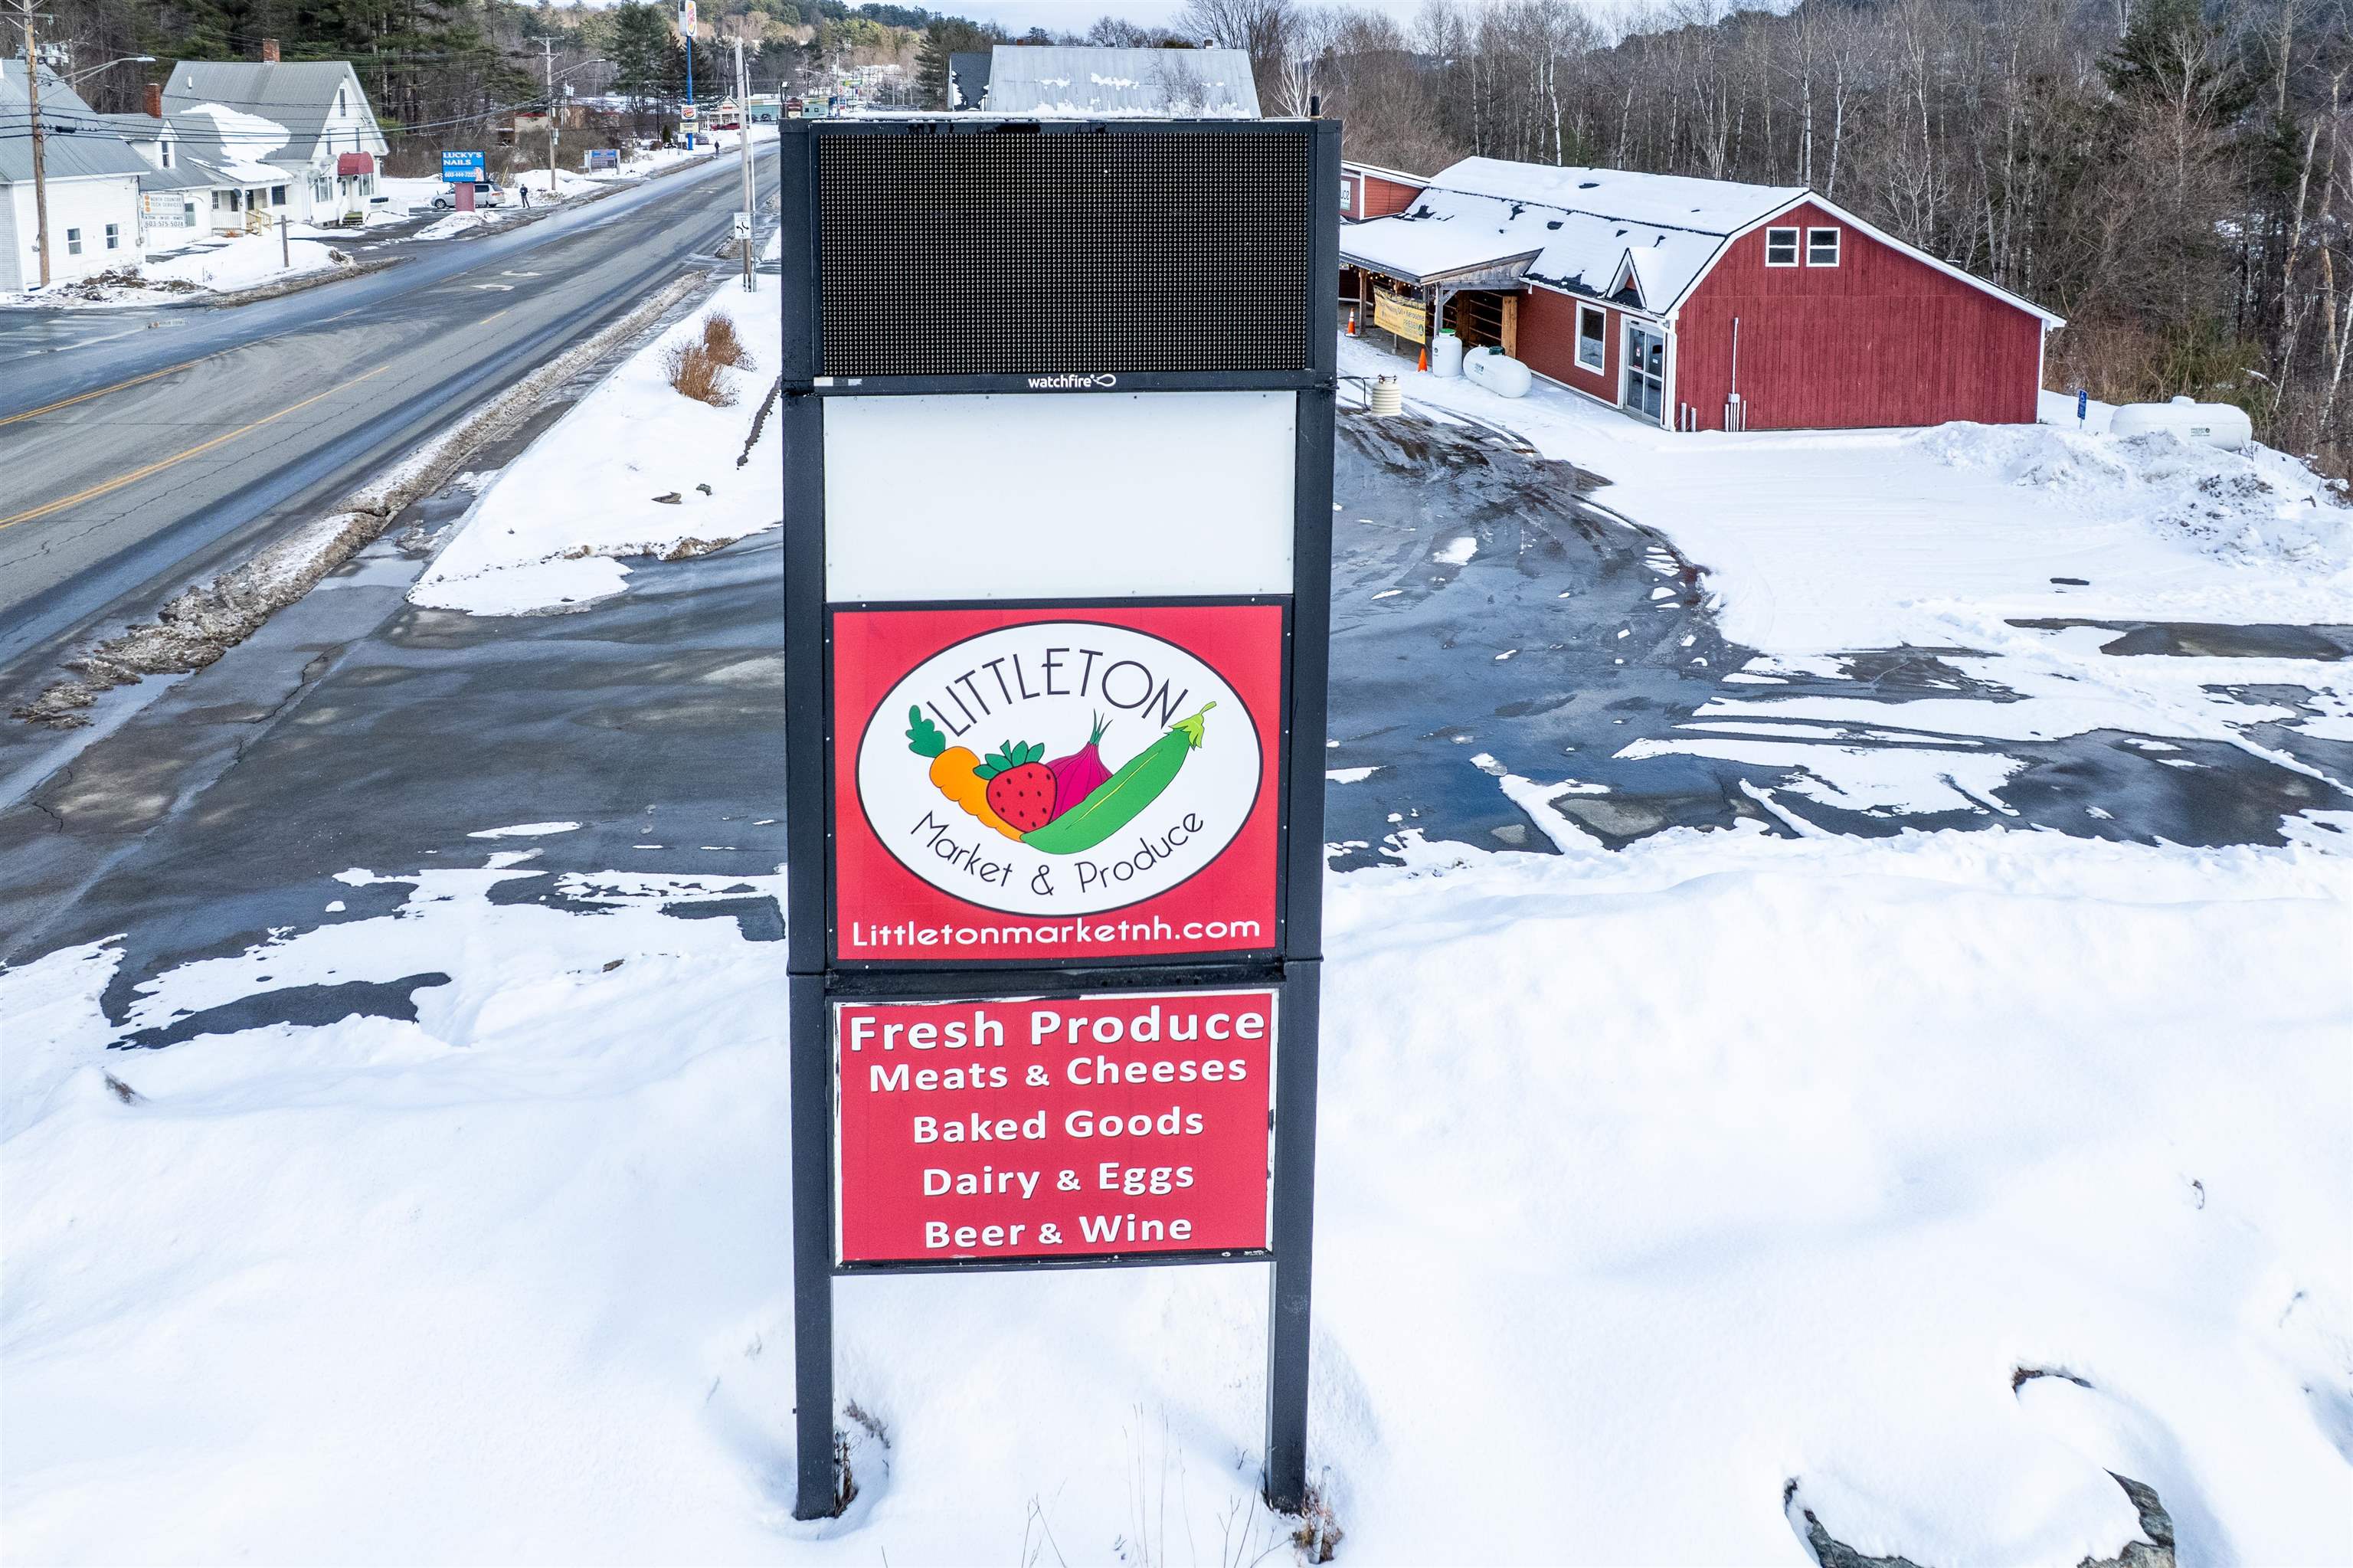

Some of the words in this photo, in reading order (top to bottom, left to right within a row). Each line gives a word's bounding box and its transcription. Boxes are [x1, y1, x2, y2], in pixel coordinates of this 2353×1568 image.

[1028, 374, 1092, 388] watchfire
[926, 647, 1189, 737] LITTLETON
[910, 810, 1013, 888] Market
[1031, 864, 1055, 896] &
[1075, 812, 1204, 893] Produce
[853, 915, 1261, 947] Littletonmarketnh.com
[850, 1010, 1005, 1052] Fresh
[1031, 1005, 1265, 1046] Produce
[869, 1062, 1008, 1093] Meats
[1025, 1063, 1050, 1087] &
[1067, 1055, 1248, 1086] Cheeses
[913, 1110, 1046, 1144] Baked
[1065, 1106, 1204, 1140] Goods
[923, 1165, 1040, 1200] Dairy
[1056, 1168, 1081, 1192] &
[1098, 1161, 1194, 1196] Eggs
[925, 1220, 1026, 1249] Beer
[1038, 1221, 1063, 1246] &
[1078, 1214, 1193, 1244] Wine
